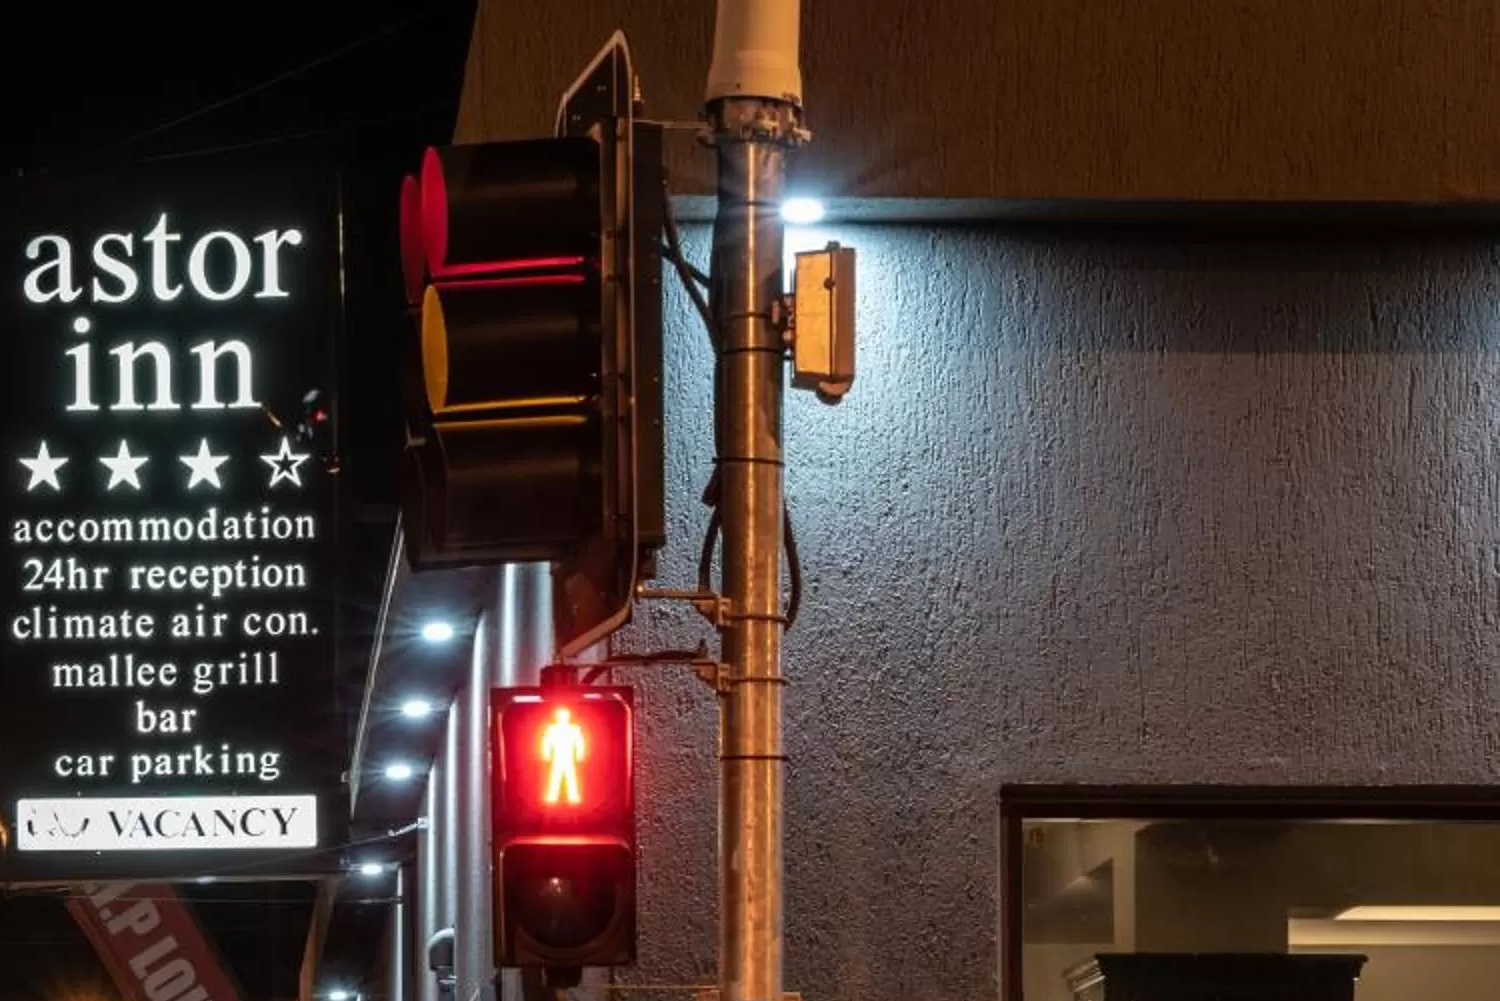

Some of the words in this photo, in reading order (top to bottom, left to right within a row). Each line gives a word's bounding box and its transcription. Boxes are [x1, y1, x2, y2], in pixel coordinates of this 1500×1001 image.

[22, 211, 303, 304] astor
[64, 316, 263, 412] inn
[12, 505, 316, 544] accommodation
[22, 557, 110, 592] 24hr
[130, 555, 307, 597] reception
[12, 605, 155, 640] climate
[171, 603, 230, 637] air
[243, 610, 320, 636] con.
[52, 653, 178, 688] mallee
[192, 651, 280, 694] grill
[135, 700, 198, 734] bar
[54, 752, 115, 777] car
[131, 743, 282, 784] parking
[107, 807, 297, 838] VACANCY
